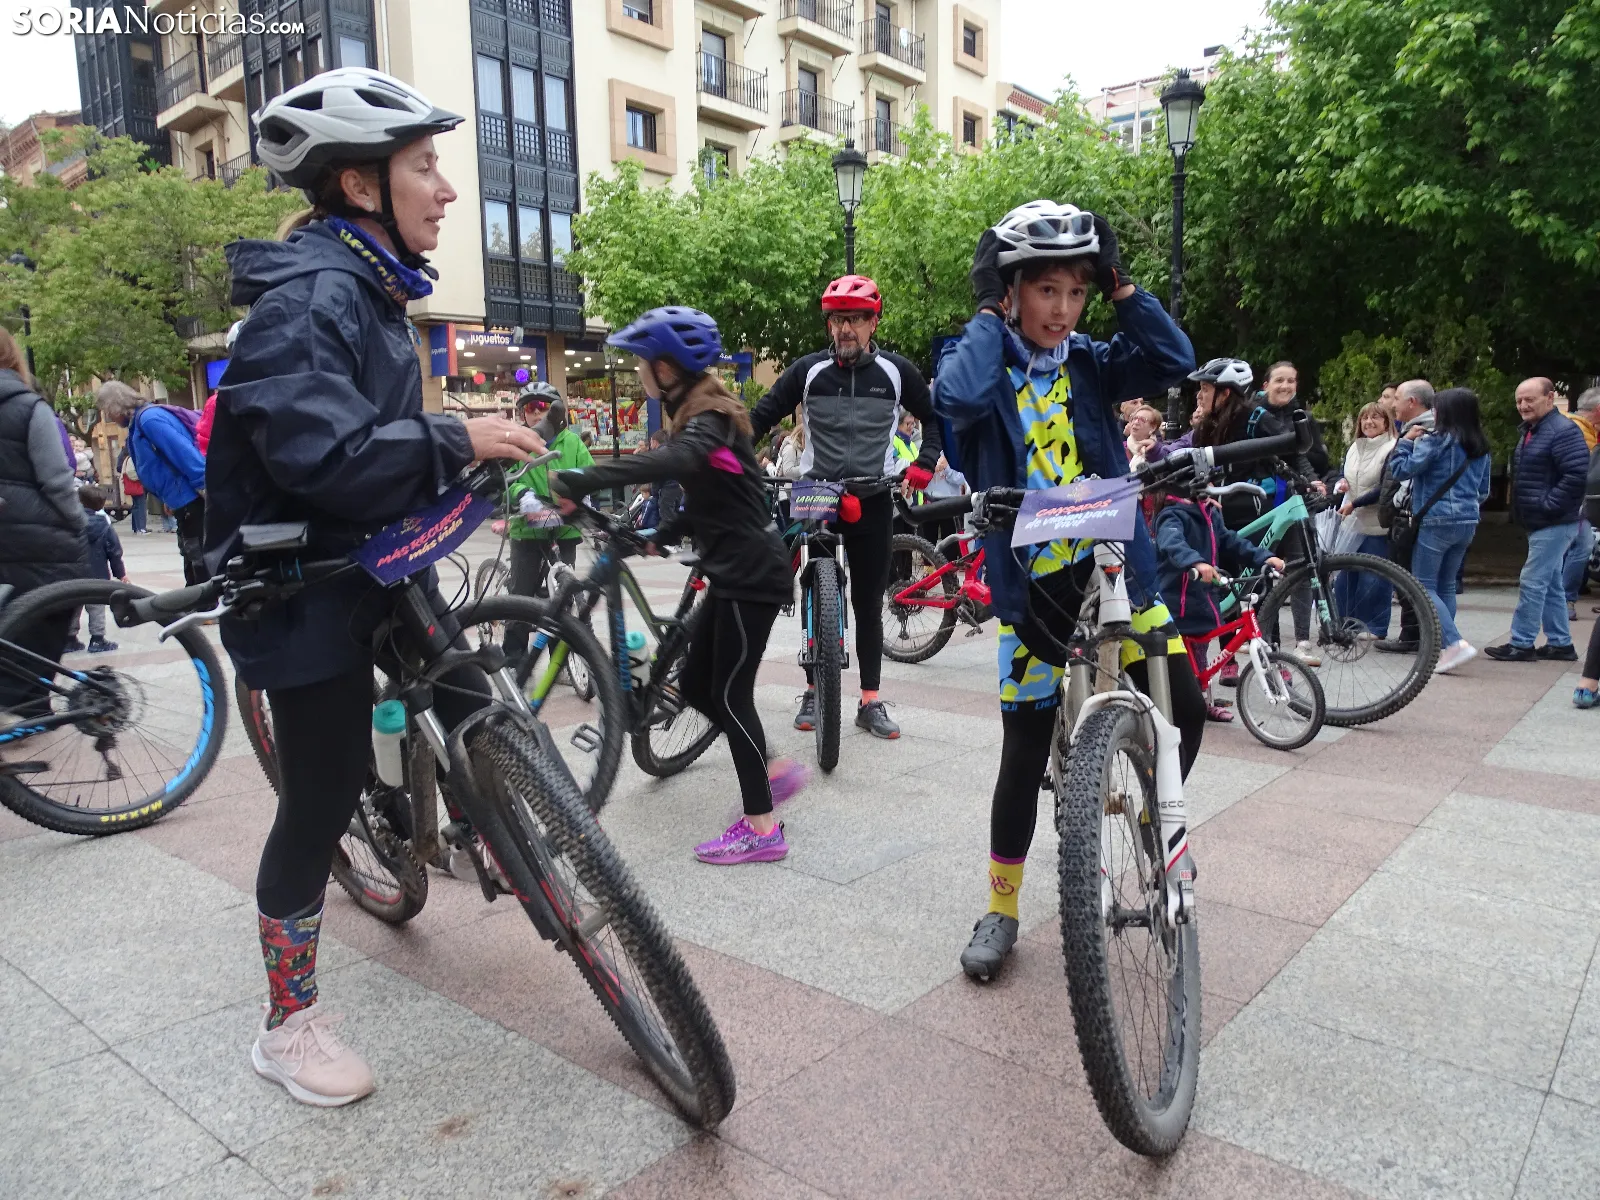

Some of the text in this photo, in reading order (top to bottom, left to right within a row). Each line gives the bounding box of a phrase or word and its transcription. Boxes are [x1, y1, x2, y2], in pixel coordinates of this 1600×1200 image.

[470, 333, 511, 346] juguettos
[410, 492, 473, 550] RECURSOS
[437, 516, 464, 543] vida
[99, 799, 163, 823] MAXXIS
